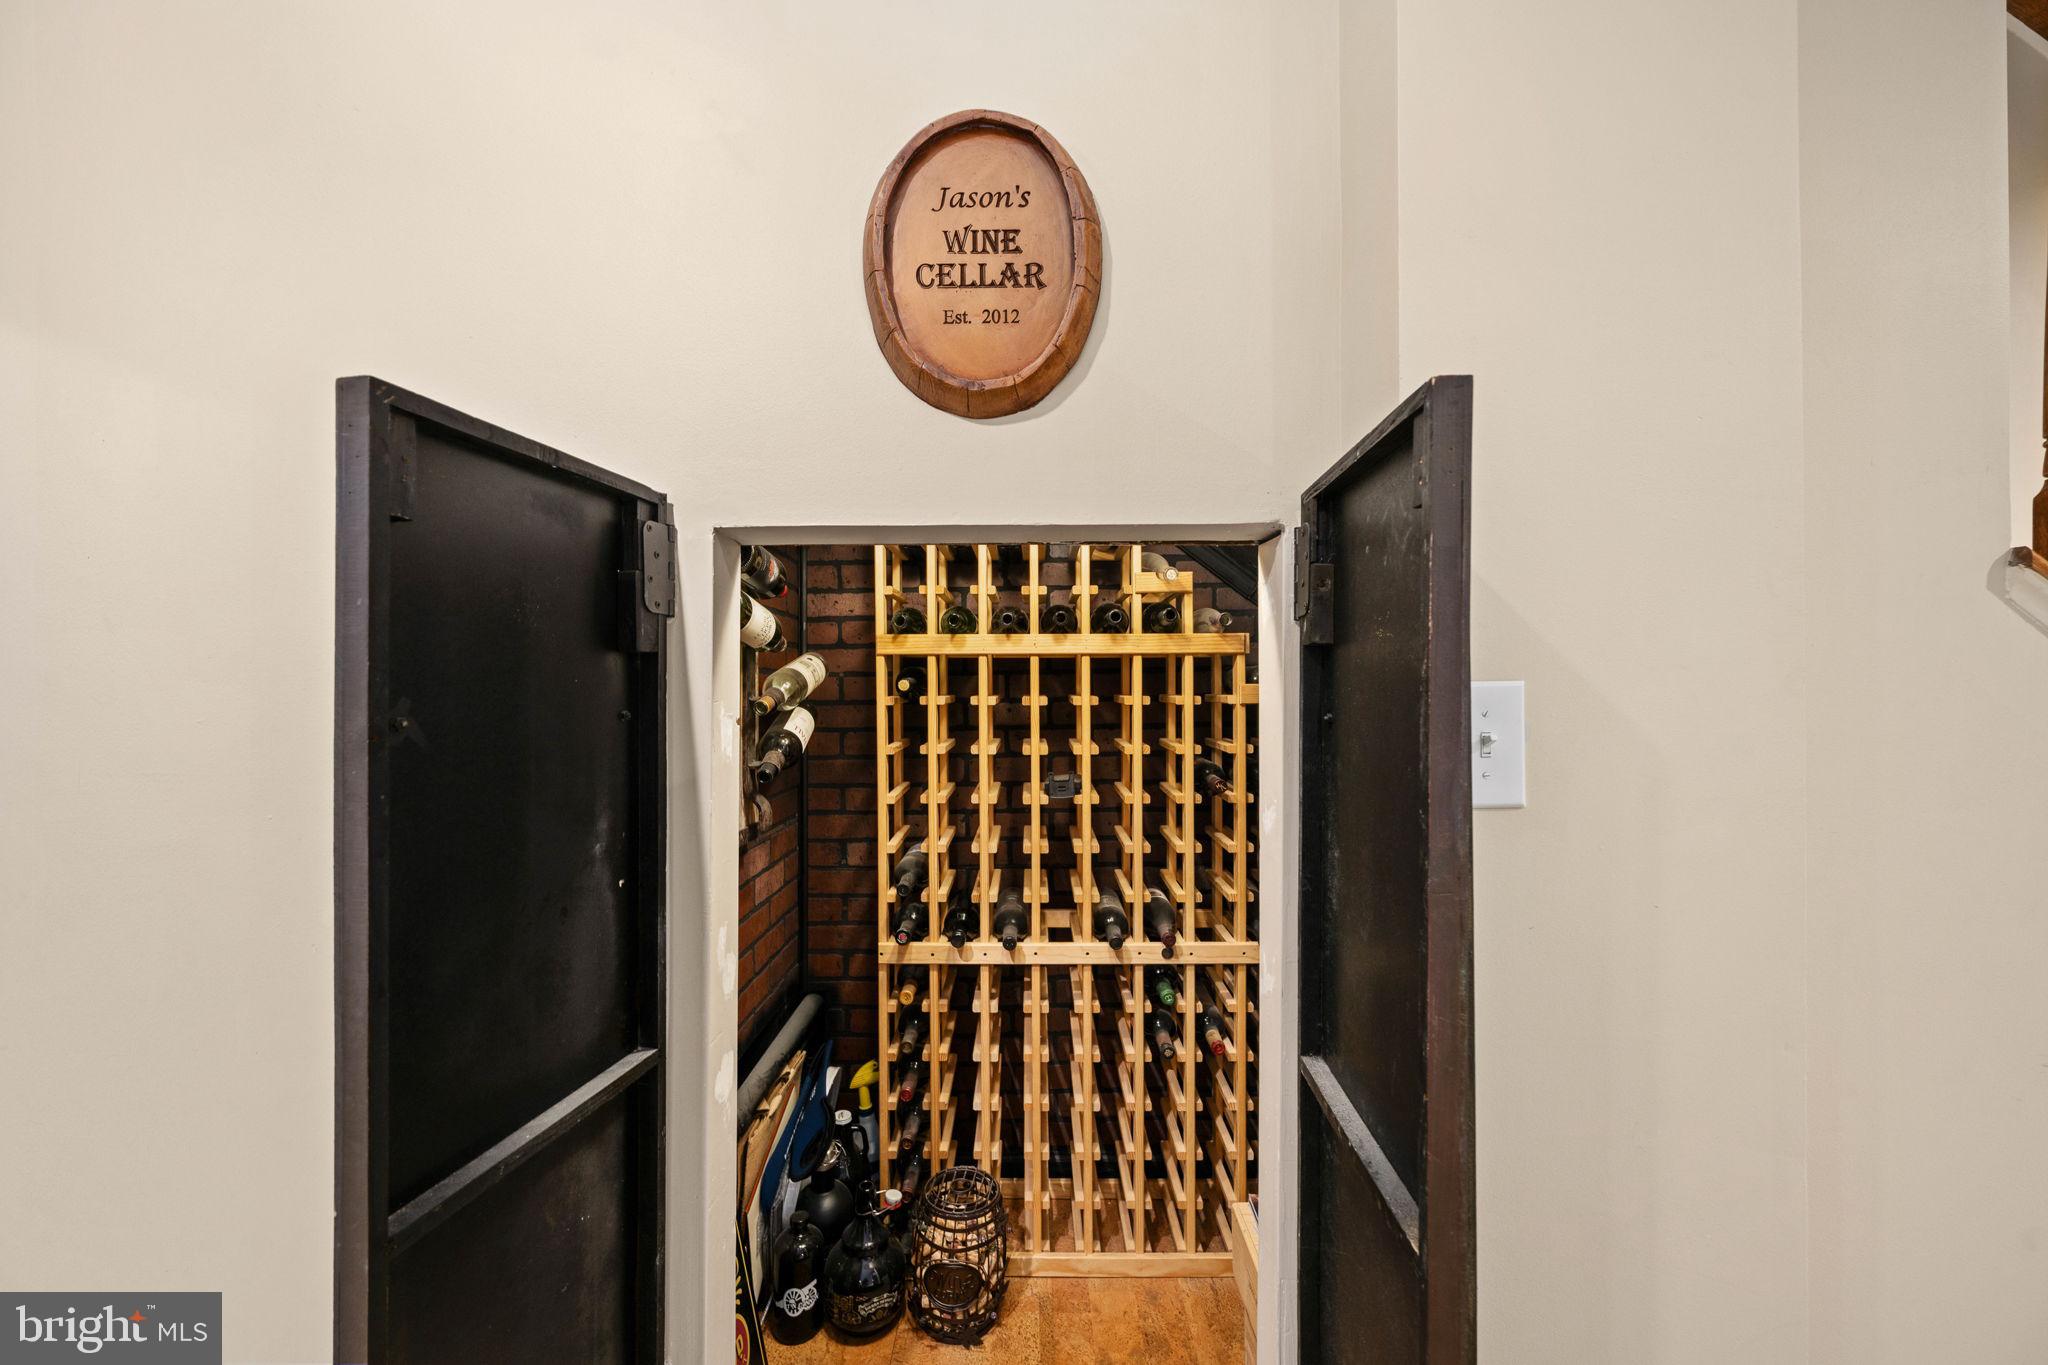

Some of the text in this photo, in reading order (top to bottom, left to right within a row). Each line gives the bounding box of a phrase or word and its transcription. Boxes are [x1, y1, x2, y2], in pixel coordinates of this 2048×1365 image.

[931, 184, 1031, 212] Jason's
[942, 223, 1024, 255] WINE
[915, 262, 1048, 291] CELLAR
[942, 308, 1021, 325] Est. 2012
